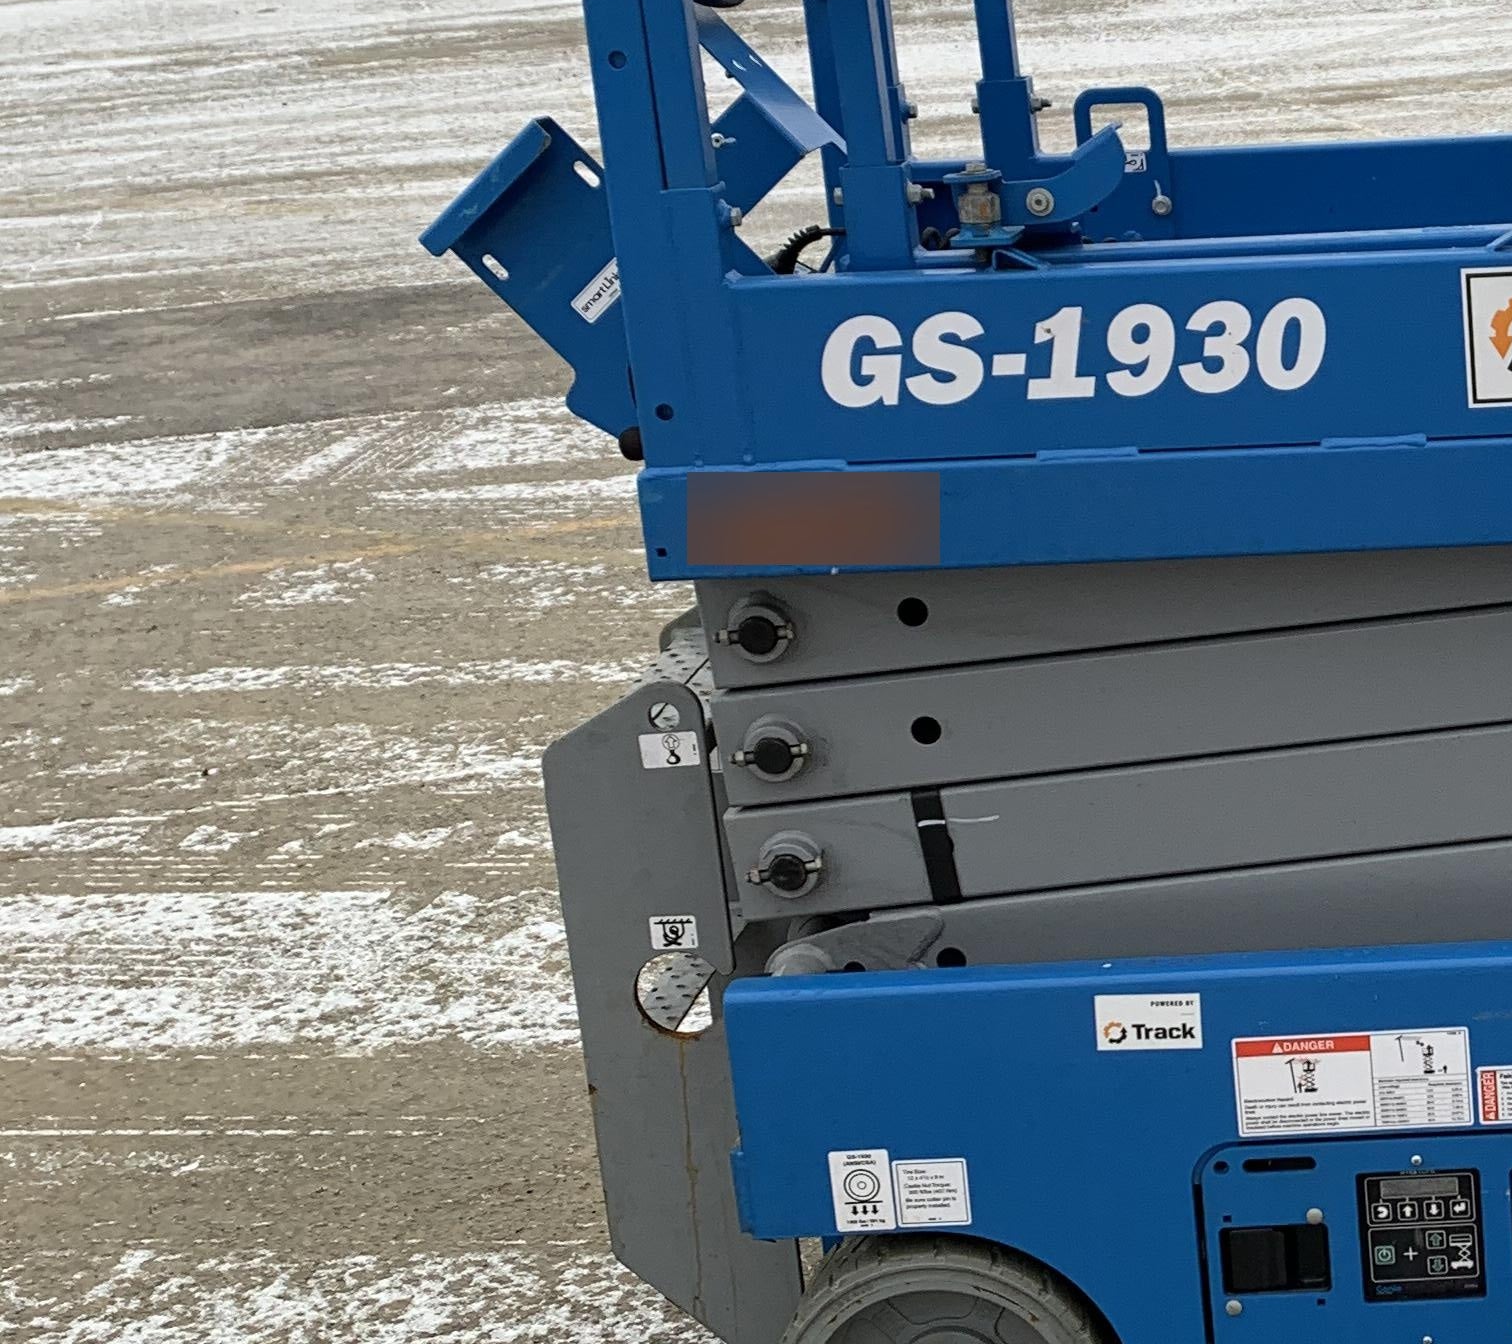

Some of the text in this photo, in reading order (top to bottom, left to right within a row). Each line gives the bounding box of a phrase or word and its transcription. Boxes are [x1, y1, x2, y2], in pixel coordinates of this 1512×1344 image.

[820, 297, 1326, 408] GS-1930
[1131, 1023, 1195, 1040] Track
[1283, 1039, 1335, 1052] DANGER
[1484, 1072, 1496, 1111] DANGER
